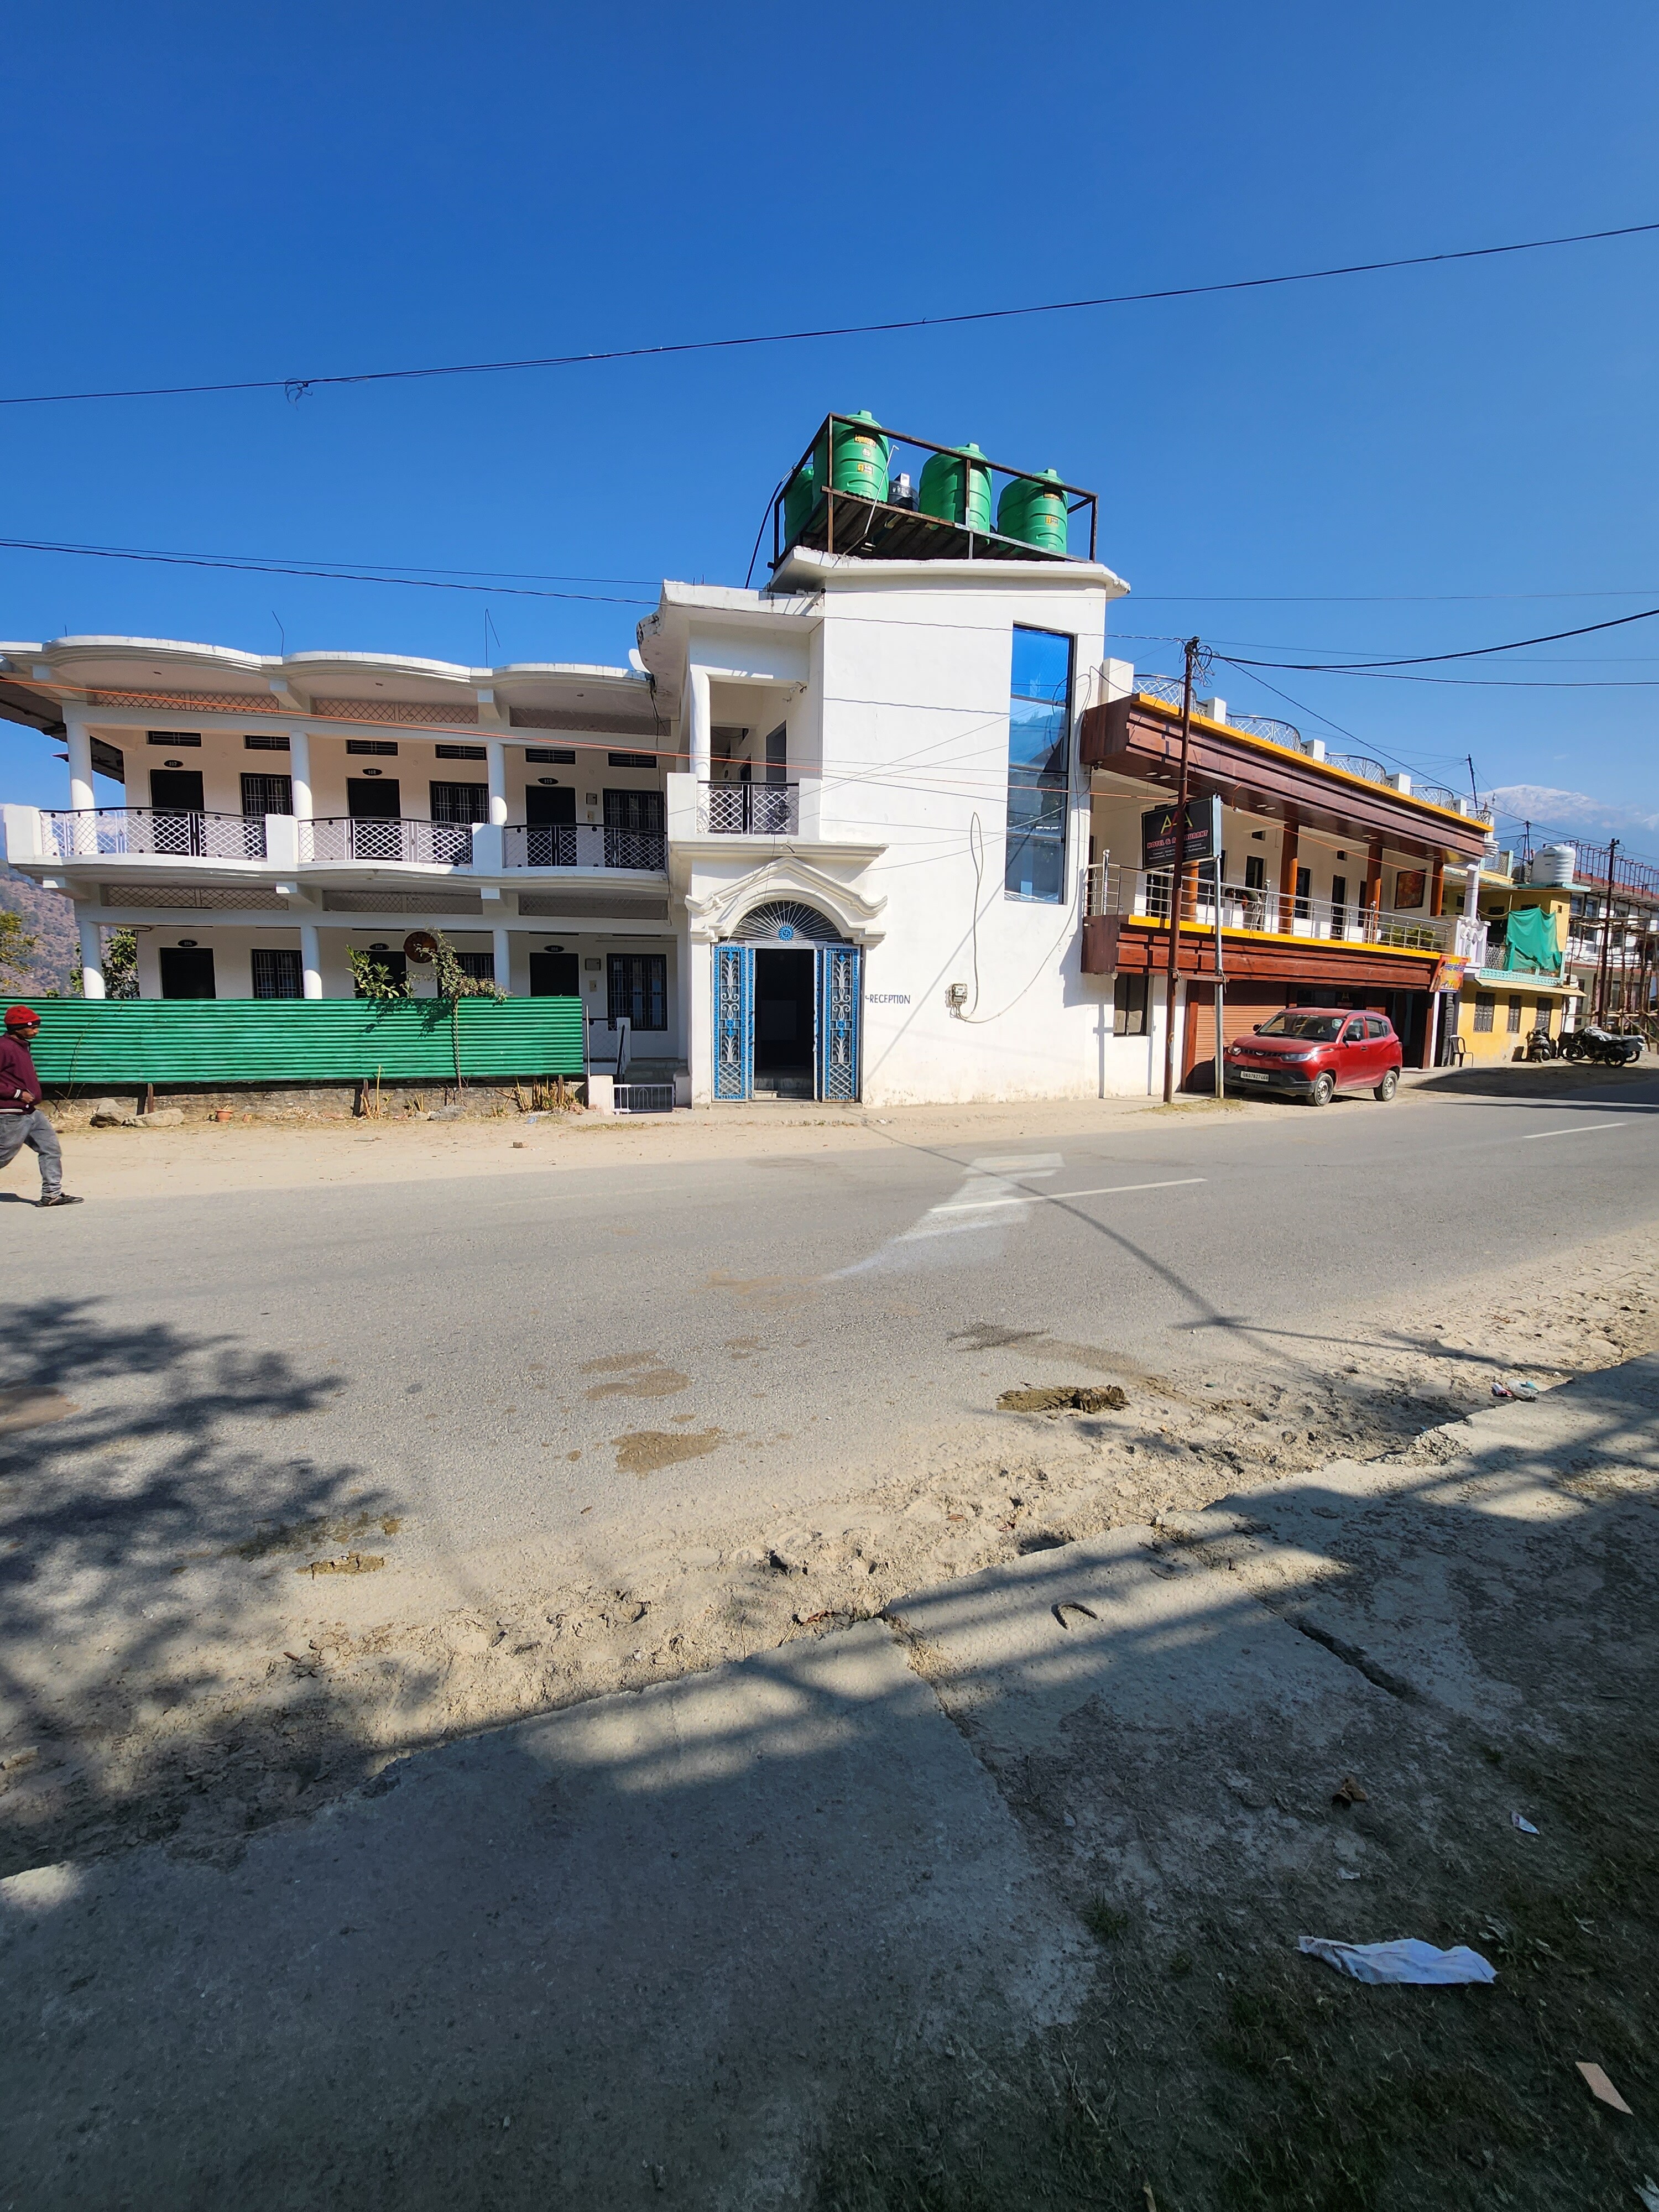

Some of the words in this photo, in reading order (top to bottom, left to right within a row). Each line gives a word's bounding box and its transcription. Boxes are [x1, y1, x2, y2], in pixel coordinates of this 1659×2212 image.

[1147, 839, 1164, 848] HOTEL
[1171, 830, 1208, 843] RAURANT
[869, 994, 911, 1004] RECEPTION
